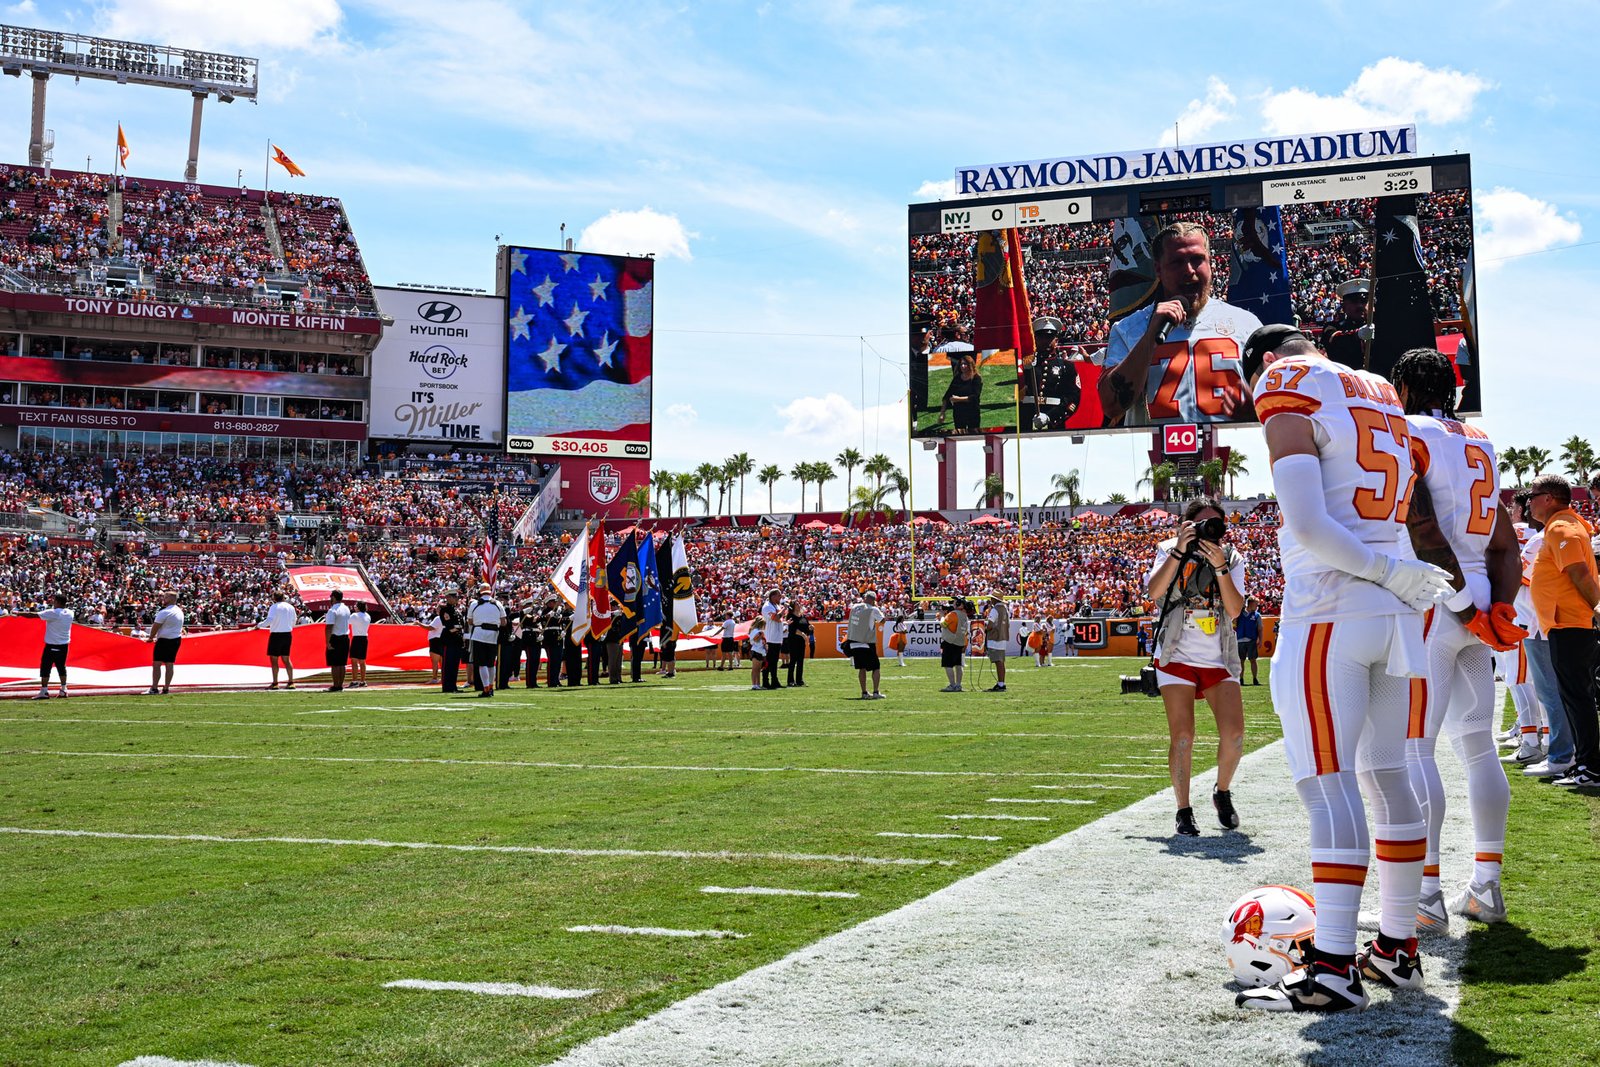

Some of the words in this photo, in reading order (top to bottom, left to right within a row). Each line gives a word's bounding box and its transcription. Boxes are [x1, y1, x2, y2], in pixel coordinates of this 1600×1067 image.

[959, 156, 1127, 194] RAYMOND
[1133, 144, 1246, 179] JAMES
[1254, 128, 1411, 167] STADIUM
[1387, 170, 1415, 178] KICKOFF
[184, 184, 201, 192] 328
[1297, 178, 1327, 186] DISTANCE
[1384, 178, 1418, 192] 3:29
[1293, 189, 1306, 200] &
[991, 208, 1003, 221] 0
[1019, 205, 1040, 218] TB
[1068, 202, 1080, 215] 0
[944, 212, 970, 225] NYJ
[64, 298, 112, 314] TONY
[117, 302, 178, 319] DUNGY
[232, 311, 290, 327] MONTE
[295, 315, 345, 331] KIFFIN
[410, 325, 468, 338] HYUNDAI
[409, 350, 440, 364] Hard
[440, 352, 468, 368] Rock
[1147, 337, 1242, 419] 76
[1265, 365, 1311, 391] 57
[419, 382, 459, 390] SPORTSBOOK
[411, 391, 434, 404] IT'S
[18, 411, 48, 422] TEXT
[51, 413, 74, 423] FAN
[77, 414, 118, 425] ISSUES
[121, 416, 137, 426] TO
[394, 402, 483, 438] Miller
[213, 421, 280, 432] 813-680-2827
[440, 423, 480, 439] TIME
[510, 440, 533, 448] 50/50
[1167, 431, 1195, 446] 40
[551, 440, 608, 454] $30,405
[625, 445, 647, 453] 50/50
[1348, 406, 1418, 524] 57
[1464, 444, 1496, 536] 2
[191, 543, 203, 551] GO
[205, 543, 228, 551] BUCS
[893, 623, 942, 634] GAZER
[1076, 624, 1099, 642] 40
